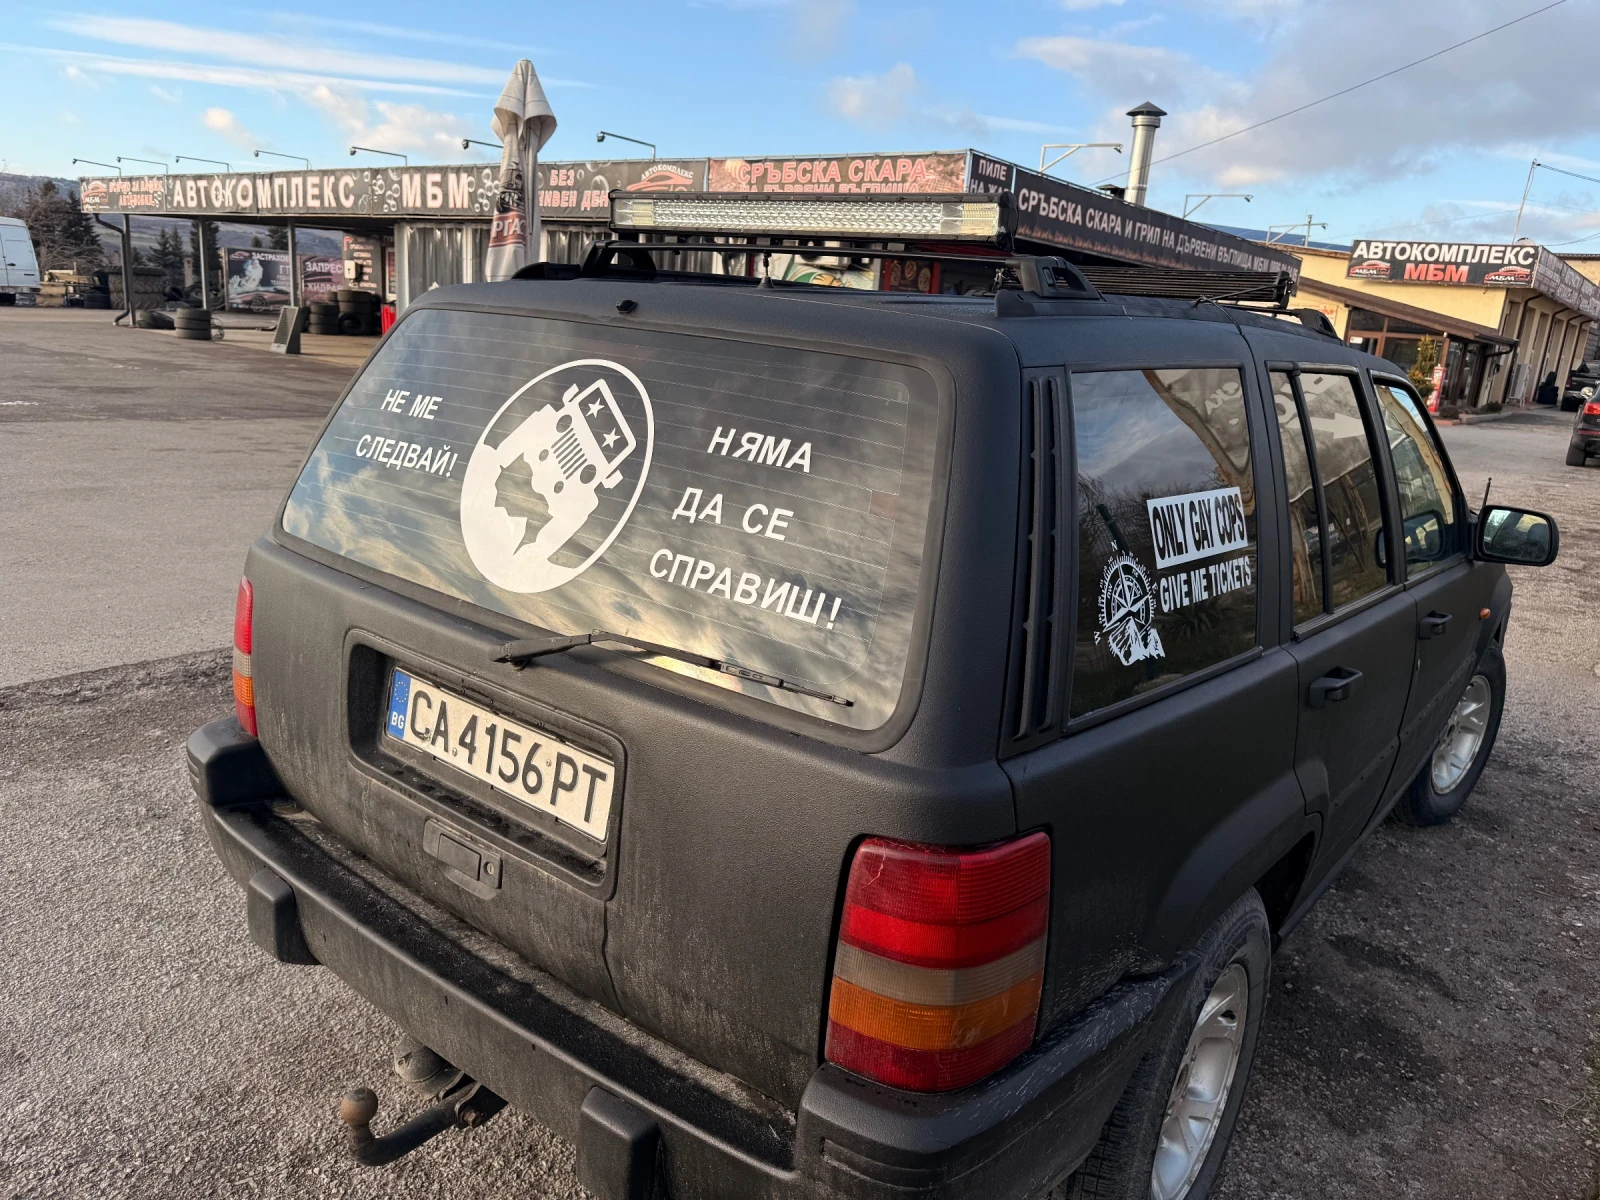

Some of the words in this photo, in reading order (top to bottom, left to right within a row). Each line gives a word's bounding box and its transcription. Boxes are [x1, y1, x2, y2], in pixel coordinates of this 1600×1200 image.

[550, 169, 575, 187] БЕЗ
[641, 164, 694, 181] АВТОКОМПЛЕКС
[738, 161, 841, 184] СРЪБСКА
[848, 158, 926, 182] СКАРА
[979, 159, 1007, 181] ПИЛЕ
[173, 174, 355, 209] АВТОКОМПЛЕКС
[401, 172, 469, 209] МБМ
[971, 179, 984, 193] НА
[581, 190, 609, 211] ДЕН
[1018, 188, 1083, 226] СРЪБСКА
[1085, 207, 1122, 236] СКАРА
[1124, 219, 1133, 238] И
[1134, 221, 1161, 244] ГРИЛ
[1162, 229, 1175, 249] НА
[1176, 234, 1217, 261] ДЪРВЕНИ
[1217, 246, 1253, 270] ВЪГЛИЩА
[252, 252, 290, 262] ЗАСТРАХОВ
[1352, 241, 1535, 265] АВТОКОМПЛЕКС
[1403, 263, 1469, 283] МБМ
[381, 389, 409, 412] НЕ
[411, 396, 442, 419] МЕ
[355, 434, 458, 477] СЛЕДВАЙ!
[707, 426, 812, 473] НЯМА
[671, 487, 723, 525] ДА
[742, 504, 794, 541] СЕ
[1152, 503, 1188, 560] ONLY
[1189, 498, 1214, 551] GAY
[1214, 493, 1245, 546] COPS
[649, 548, 842, 630] СПРАВИШ!
[1160, 574, 1190, 613] GIVE
[1190, 567, 1209, 604] ME
[1209, 556, 1252, 597] TICKETS
[391, 711, 405, 729] BG
[458, 714, 543, 795] 4156
